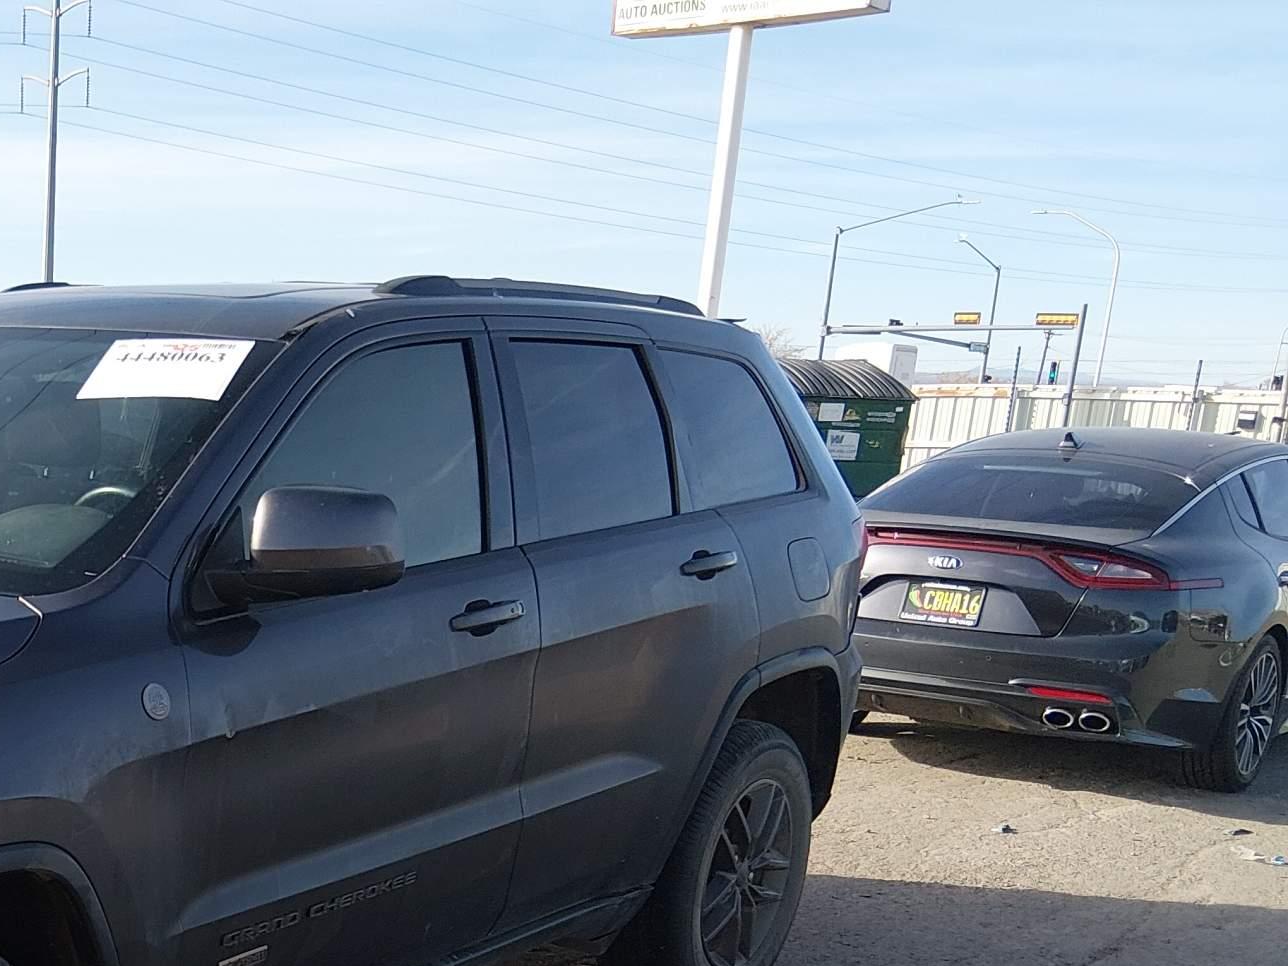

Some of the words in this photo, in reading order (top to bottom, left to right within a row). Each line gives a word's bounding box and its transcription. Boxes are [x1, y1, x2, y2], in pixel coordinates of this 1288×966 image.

[618, 4, 647, 20] AUTO
[651, 0, 706, 17] AUCTIONS
[933, 556, 958, 569] KIA
[220, 911, 300, 947] GRAND
[306, 871, 417, 919] CHEROKEE
